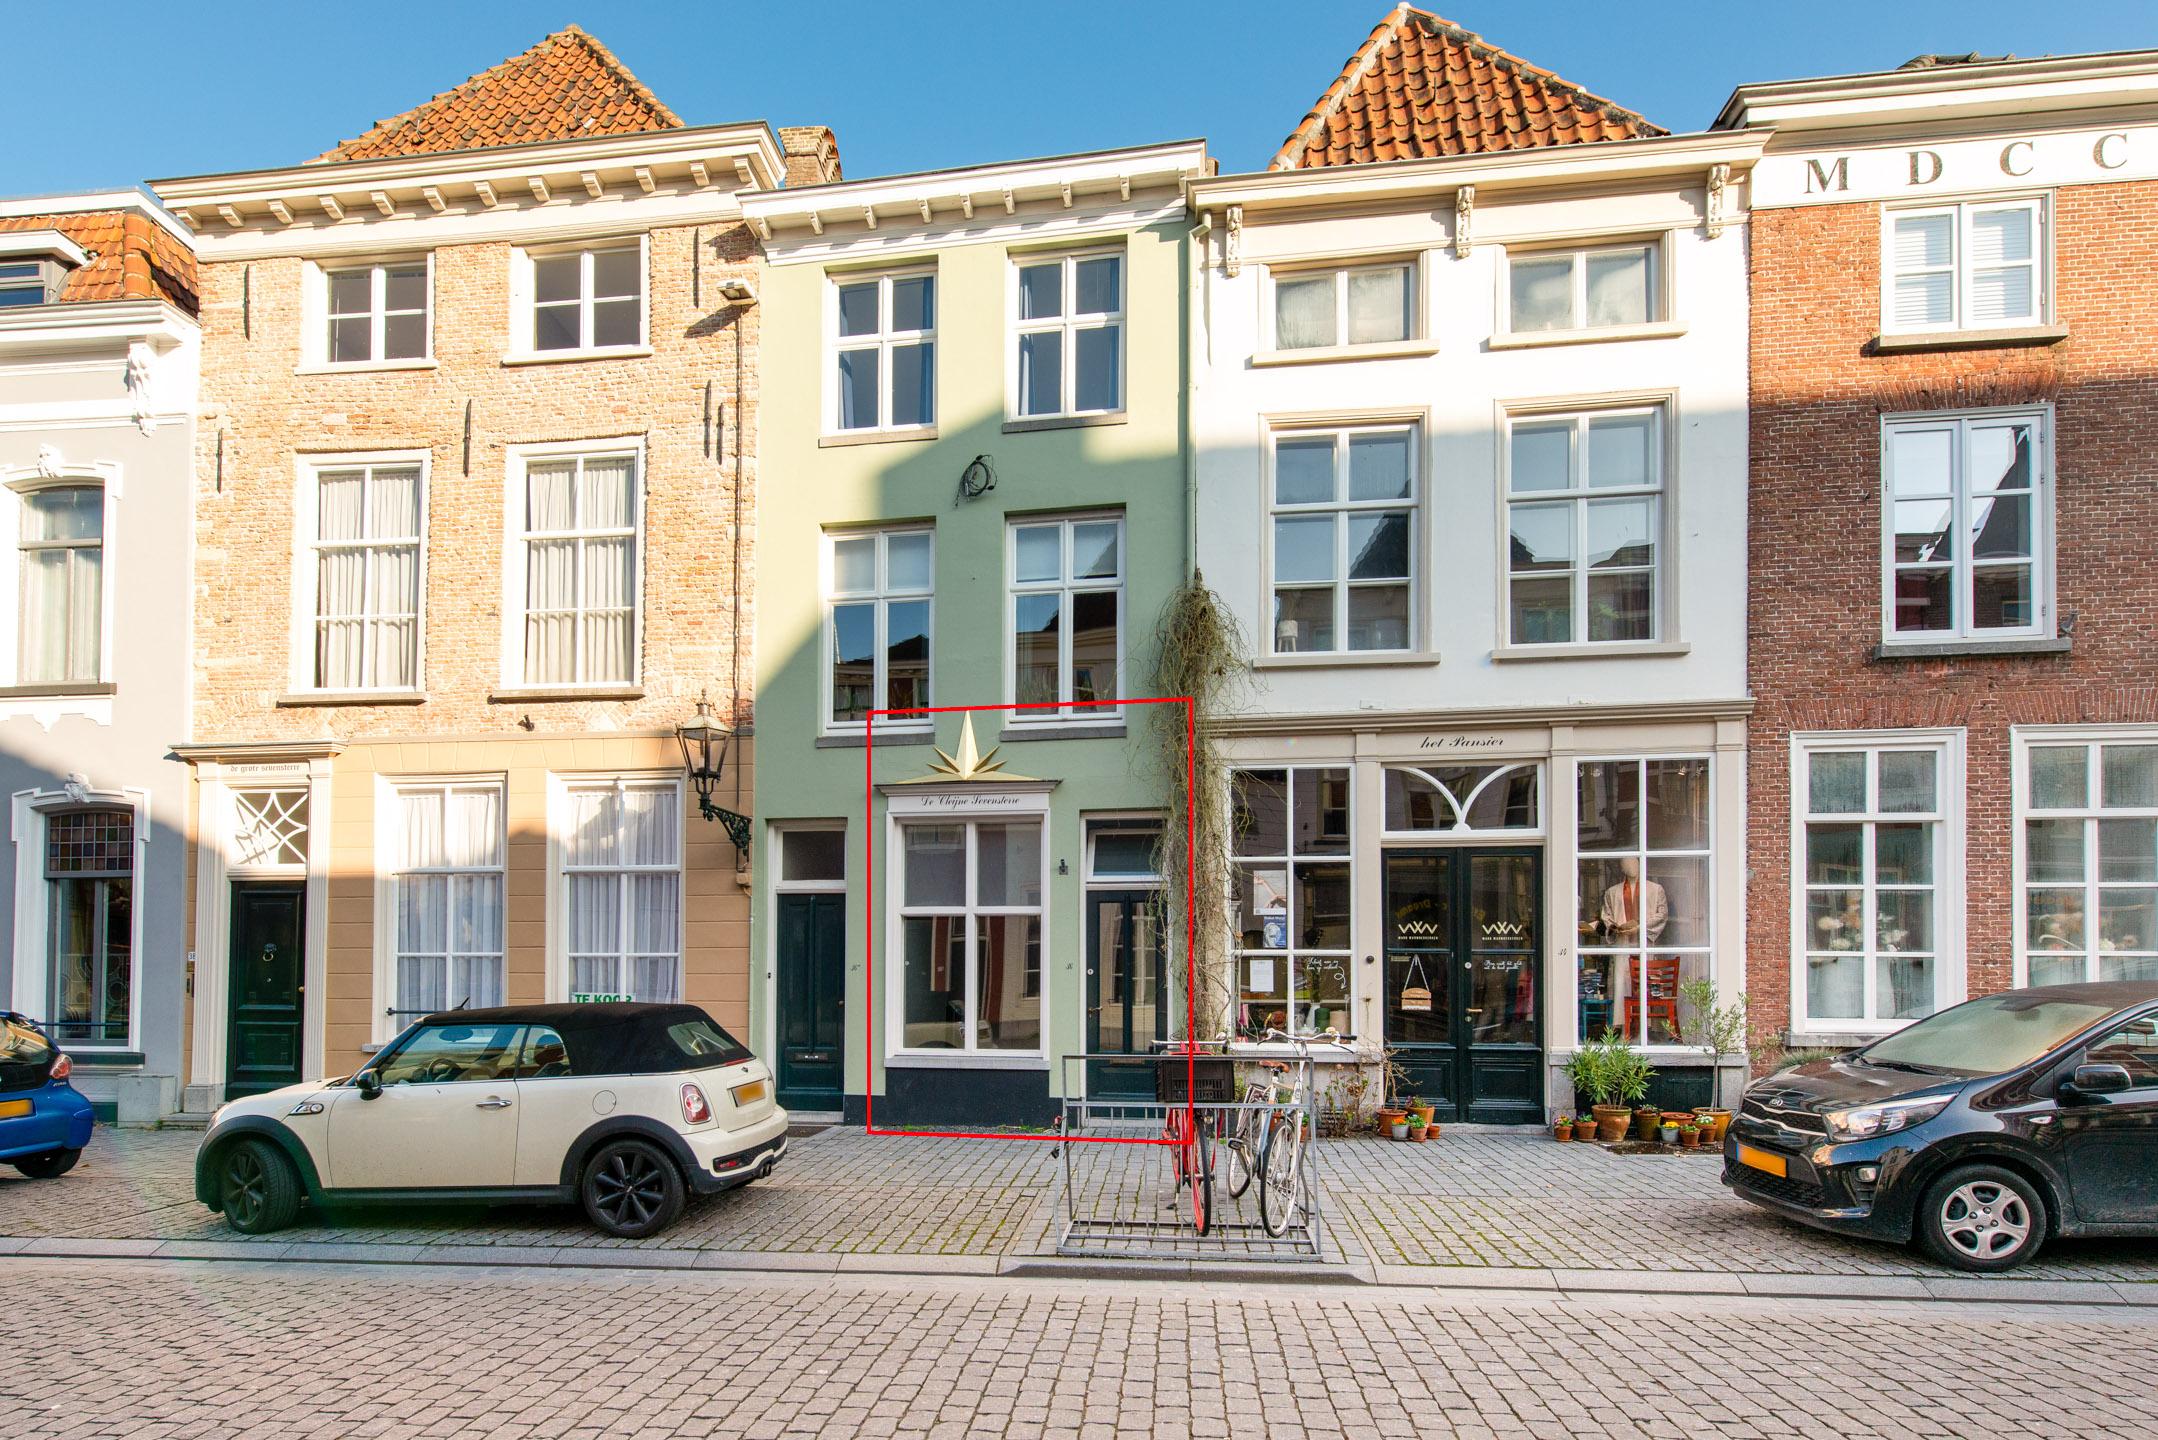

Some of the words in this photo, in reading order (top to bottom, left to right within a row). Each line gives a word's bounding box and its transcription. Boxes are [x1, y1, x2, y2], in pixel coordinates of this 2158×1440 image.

[1420, 736, 1444, 749] het
[1449, 735, 1505, 748] Pansier
[575, 994, 589, 1004] TE
